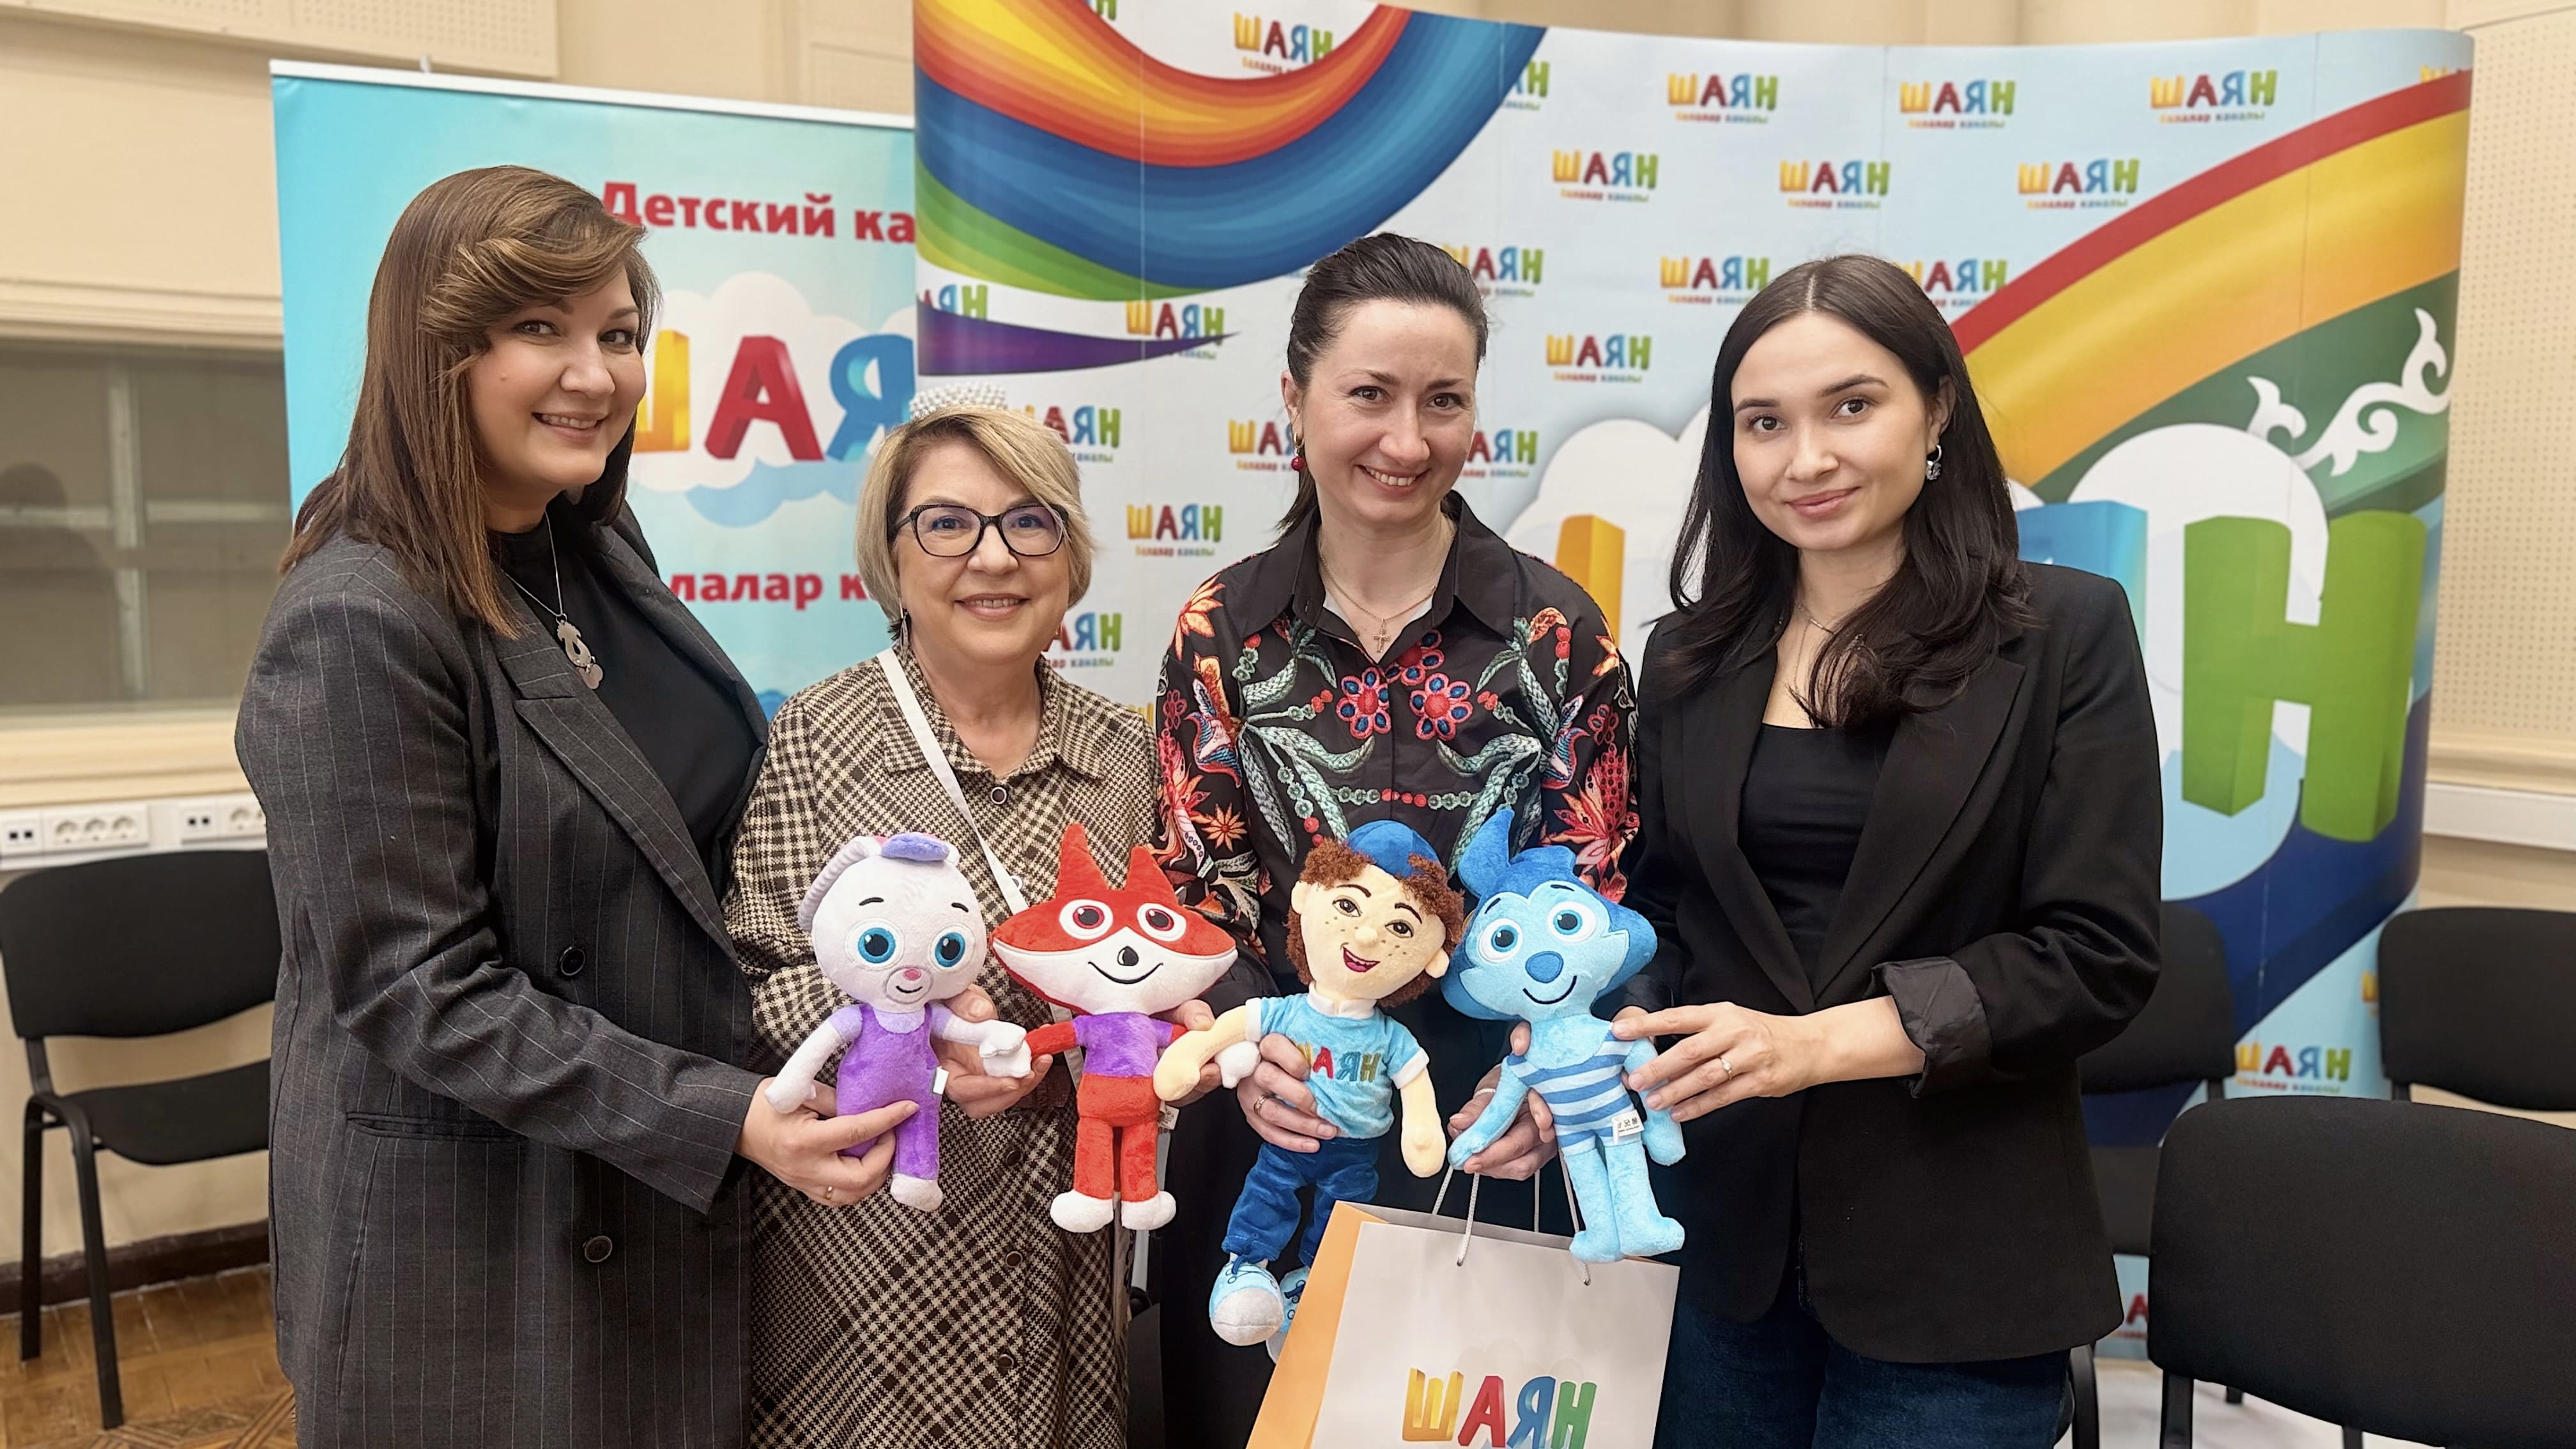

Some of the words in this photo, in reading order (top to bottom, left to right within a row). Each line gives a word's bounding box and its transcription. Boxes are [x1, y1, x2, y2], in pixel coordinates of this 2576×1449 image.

[1234, 12, 1333, 63] ШАЯН
[1667, 73, 1777, 111] ШАЯН
[1900, 79, 2015, 115] ШАЯН
[2150, 68, 2278, 109] ШАЯН
[1552, 150, 1658, 190] ШАЯН
[1780, 159, 1889, 196] ШАЯН
[2018, 158, 2140, 194] ШАЯН
[603, 181, 835, 237] Детский
[1660, 256, 1769, 291] ШАЯН
[1126, 300, 1224, 346] ШАЯН
[1545, 334, 1651, 370] ШАЯН
[1025, 404, 1121, 448] АЯН
[1126, 503, 1223, 543] ШАЯН
[1402, 1367, 1597, 1449] ШАЯН
